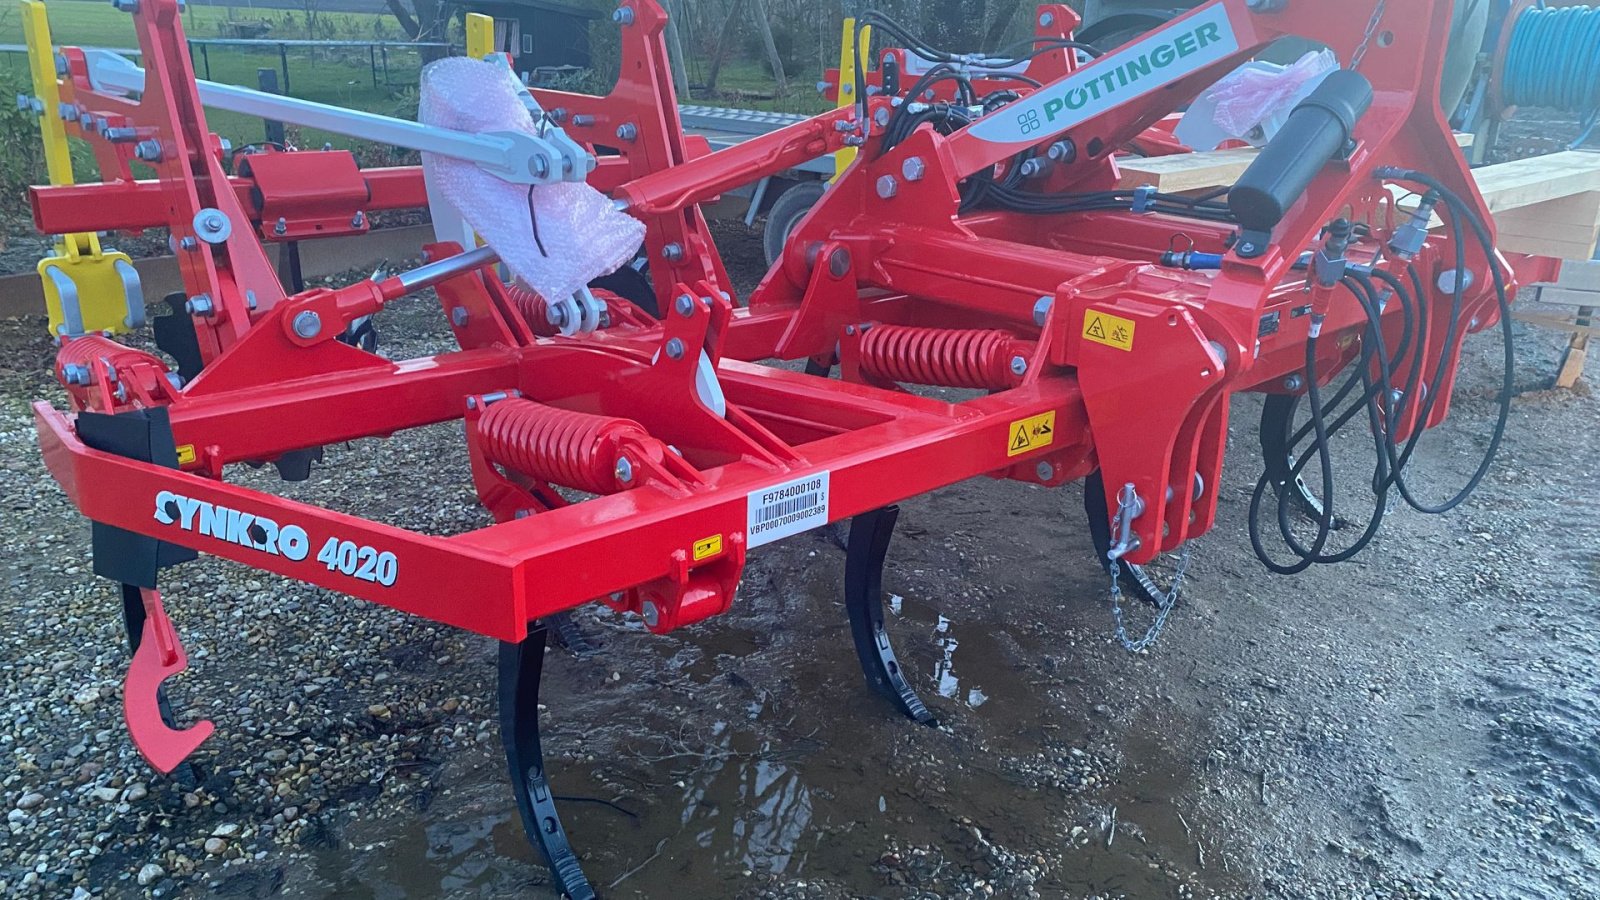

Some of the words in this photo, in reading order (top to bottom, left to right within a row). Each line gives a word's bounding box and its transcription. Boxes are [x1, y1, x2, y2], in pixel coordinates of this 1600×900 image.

[763, 479, 821, 504] F9784000108
[750, 505, 825, 534] VBP00070009002389
[154, 491, 310, 562] SYNKRO
[317, 537, 399, 588] 4020
